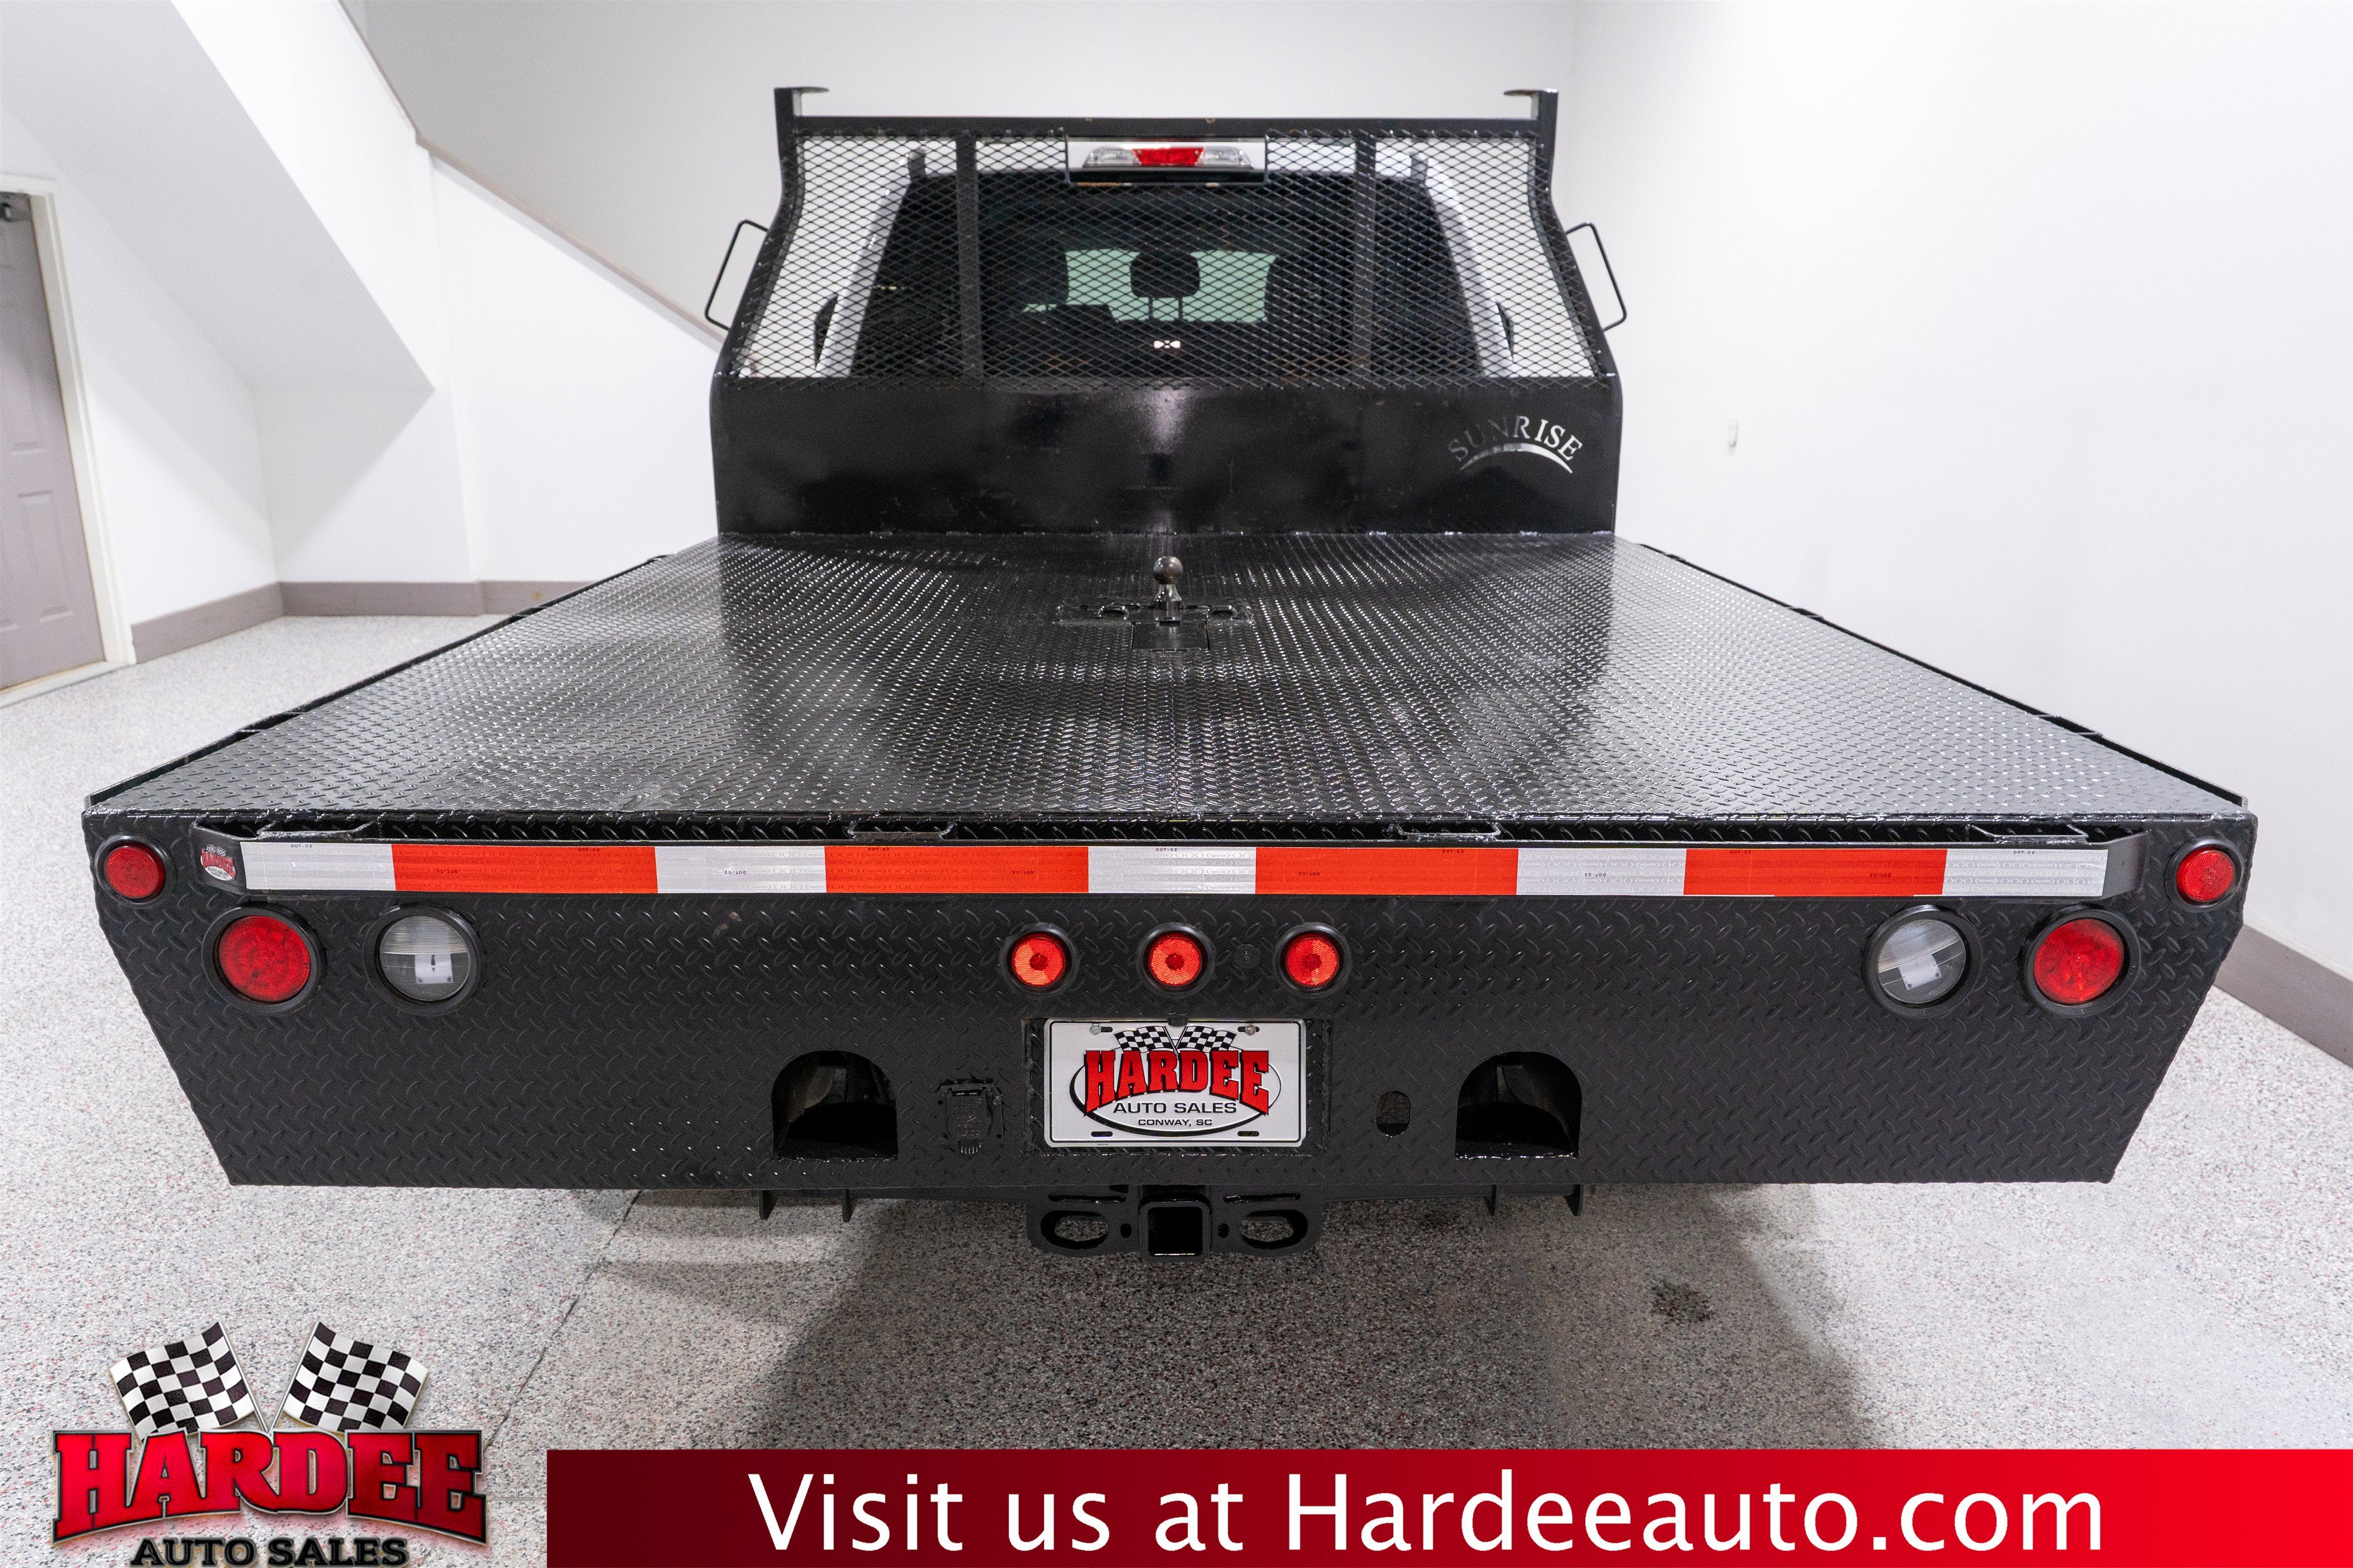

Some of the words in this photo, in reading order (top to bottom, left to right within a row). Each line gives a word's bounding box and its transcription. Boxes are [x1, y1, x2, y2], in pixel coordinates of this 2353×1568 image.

[1448, 415, 1583, 462] SUNRISE
[1083, 1049, 1269, 1117] HARDEE
[1113, 1102, 1167, 1113] AUTO
[1174, 1102, 1237, 1114] SALES
[1138, 1119, 1191, 1127] CONWAY,
